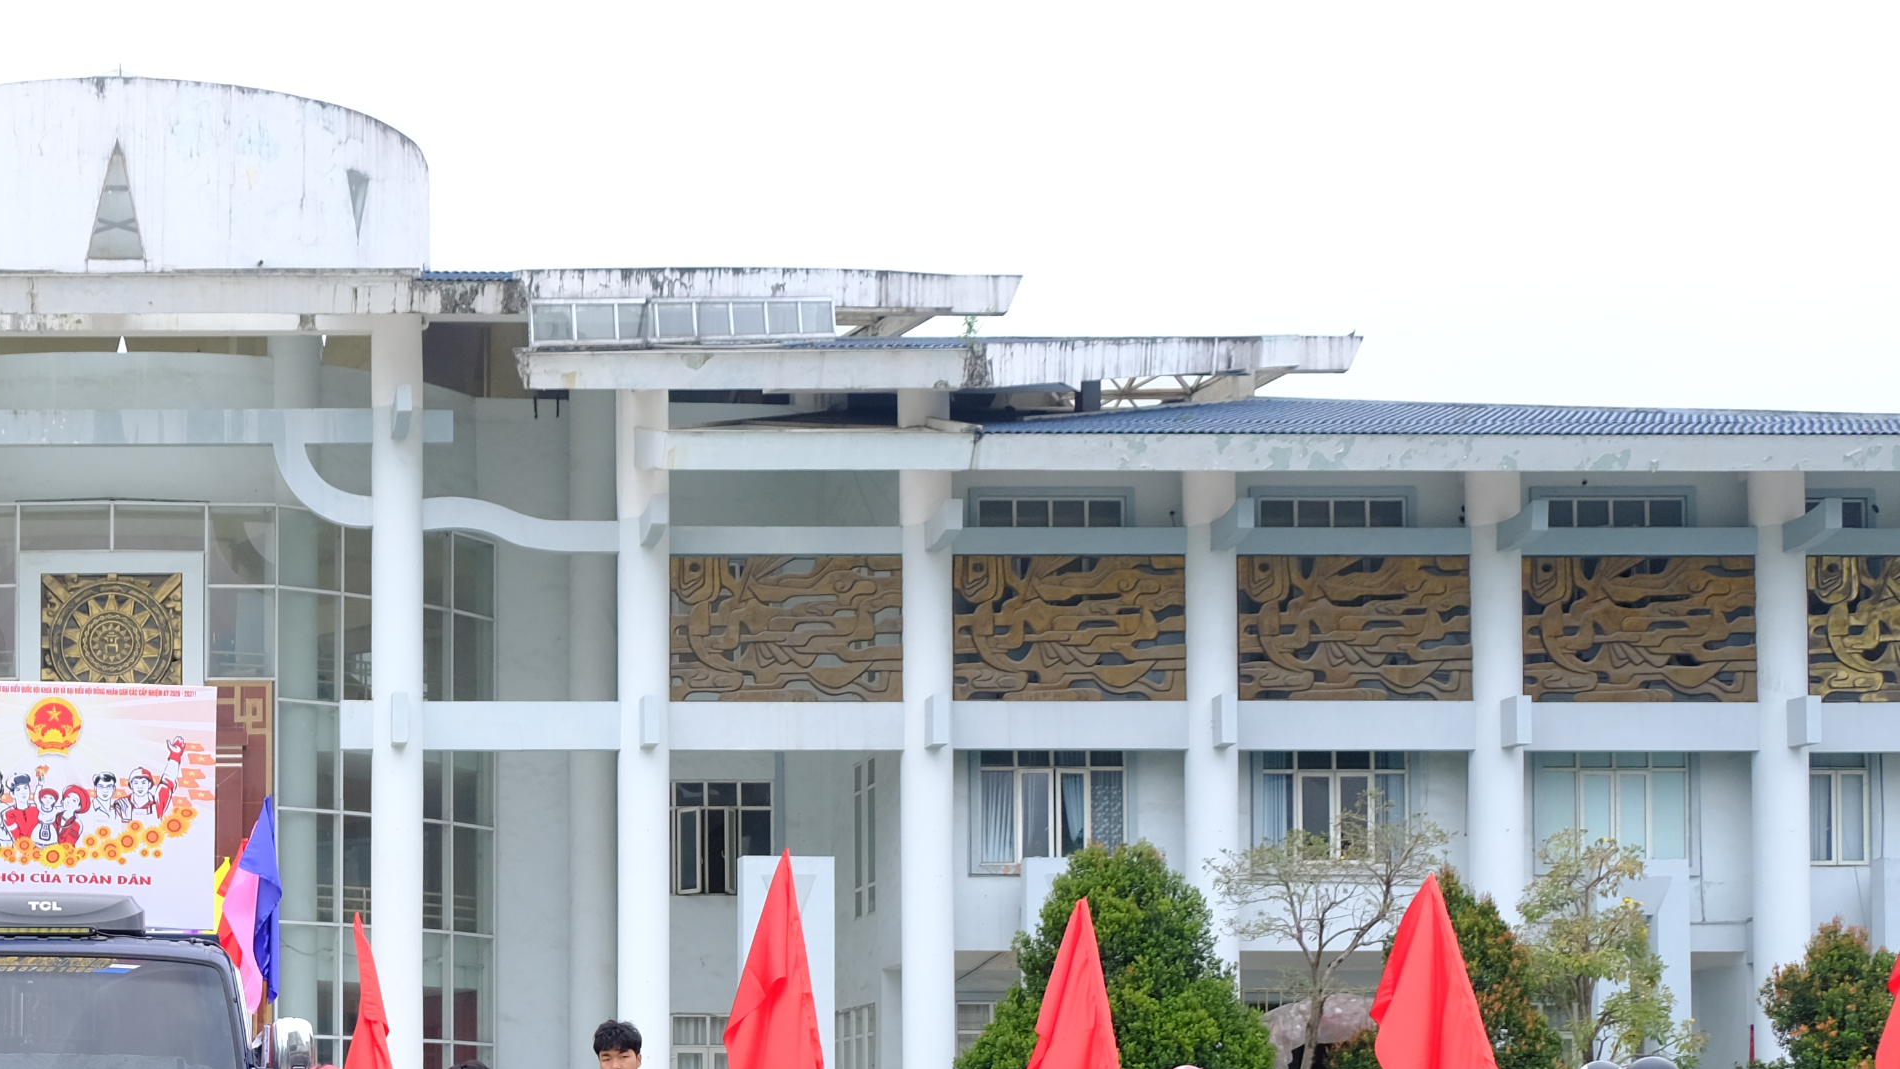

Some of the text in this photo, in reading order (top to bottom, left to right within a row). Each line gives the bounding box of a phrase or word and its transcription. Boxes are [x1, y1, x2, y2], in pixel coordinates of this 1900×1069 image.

[30, 871, 61, 883] CỦA
[66, 873, 112, 884] TOÀN
[118, 874, 151, 885] DÂN
[28, 901, 62, 911] TCL
